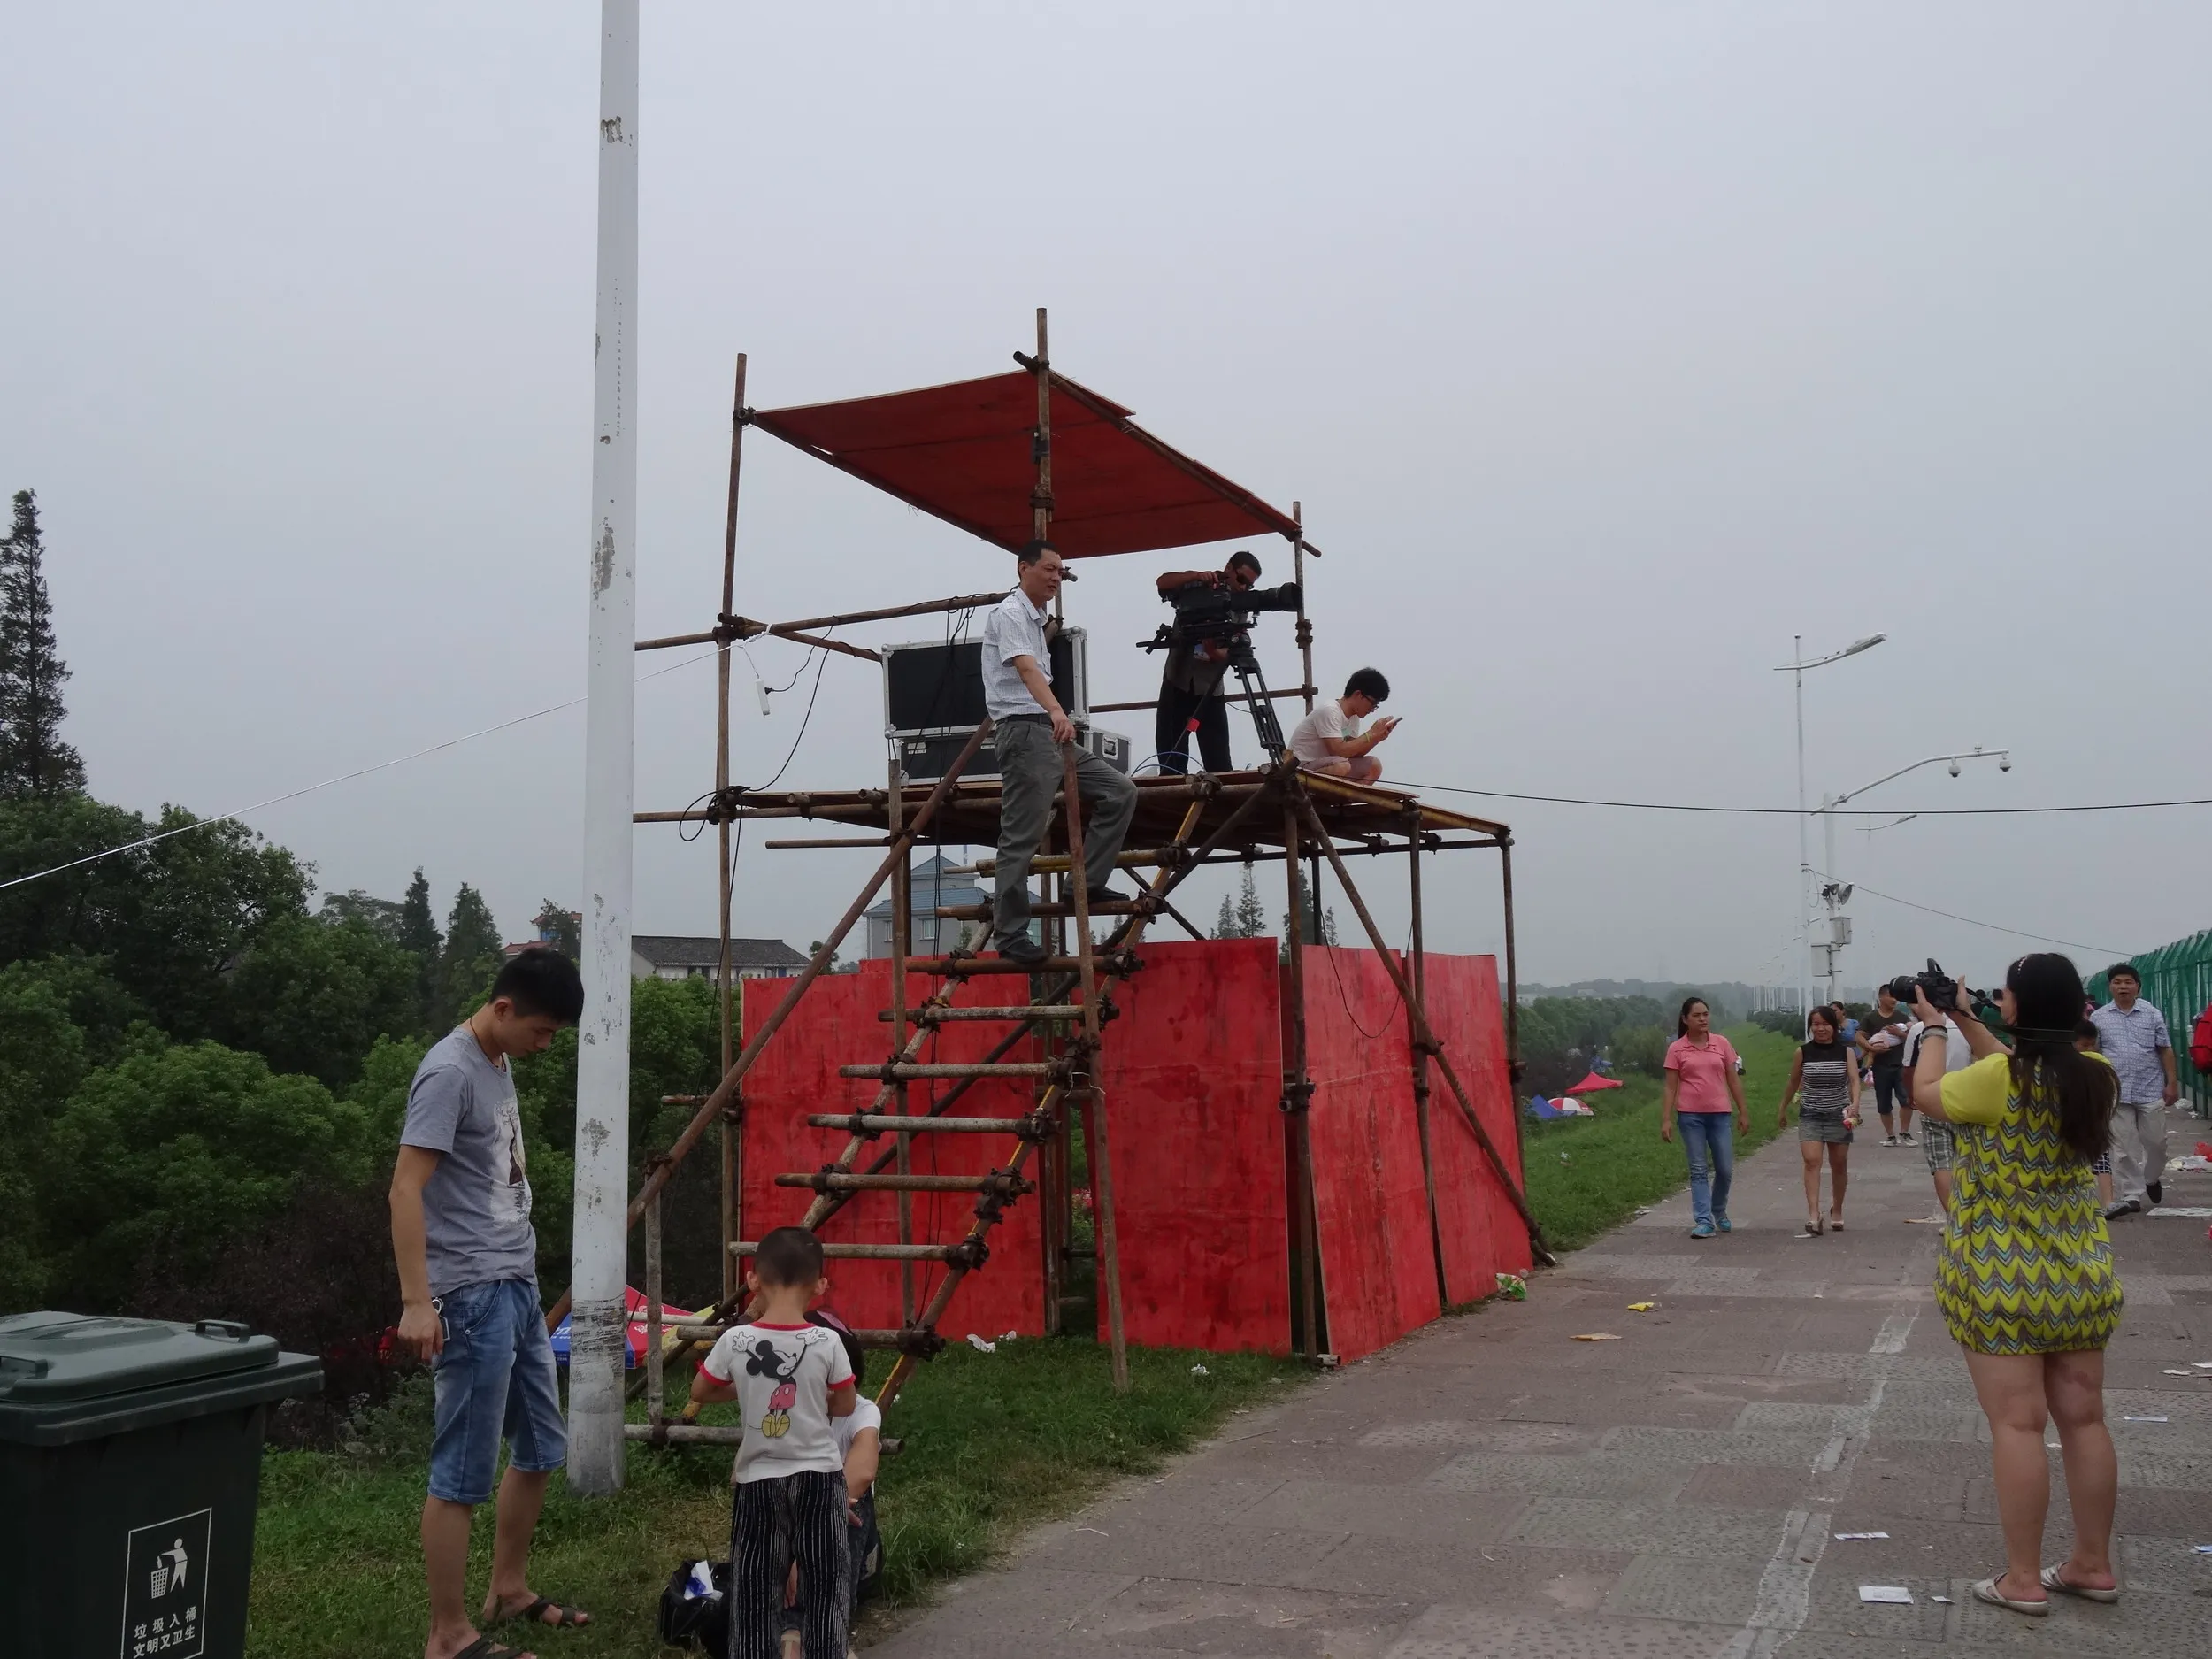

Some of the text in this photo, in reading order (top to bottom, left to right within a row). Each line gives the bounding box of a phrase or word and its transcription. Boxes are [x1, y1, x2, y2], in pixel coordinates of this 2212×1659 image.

[134, 1606, 196, 1639] 垃圾入桶
[133, 1624, 195, 1659] 文明又卫生
